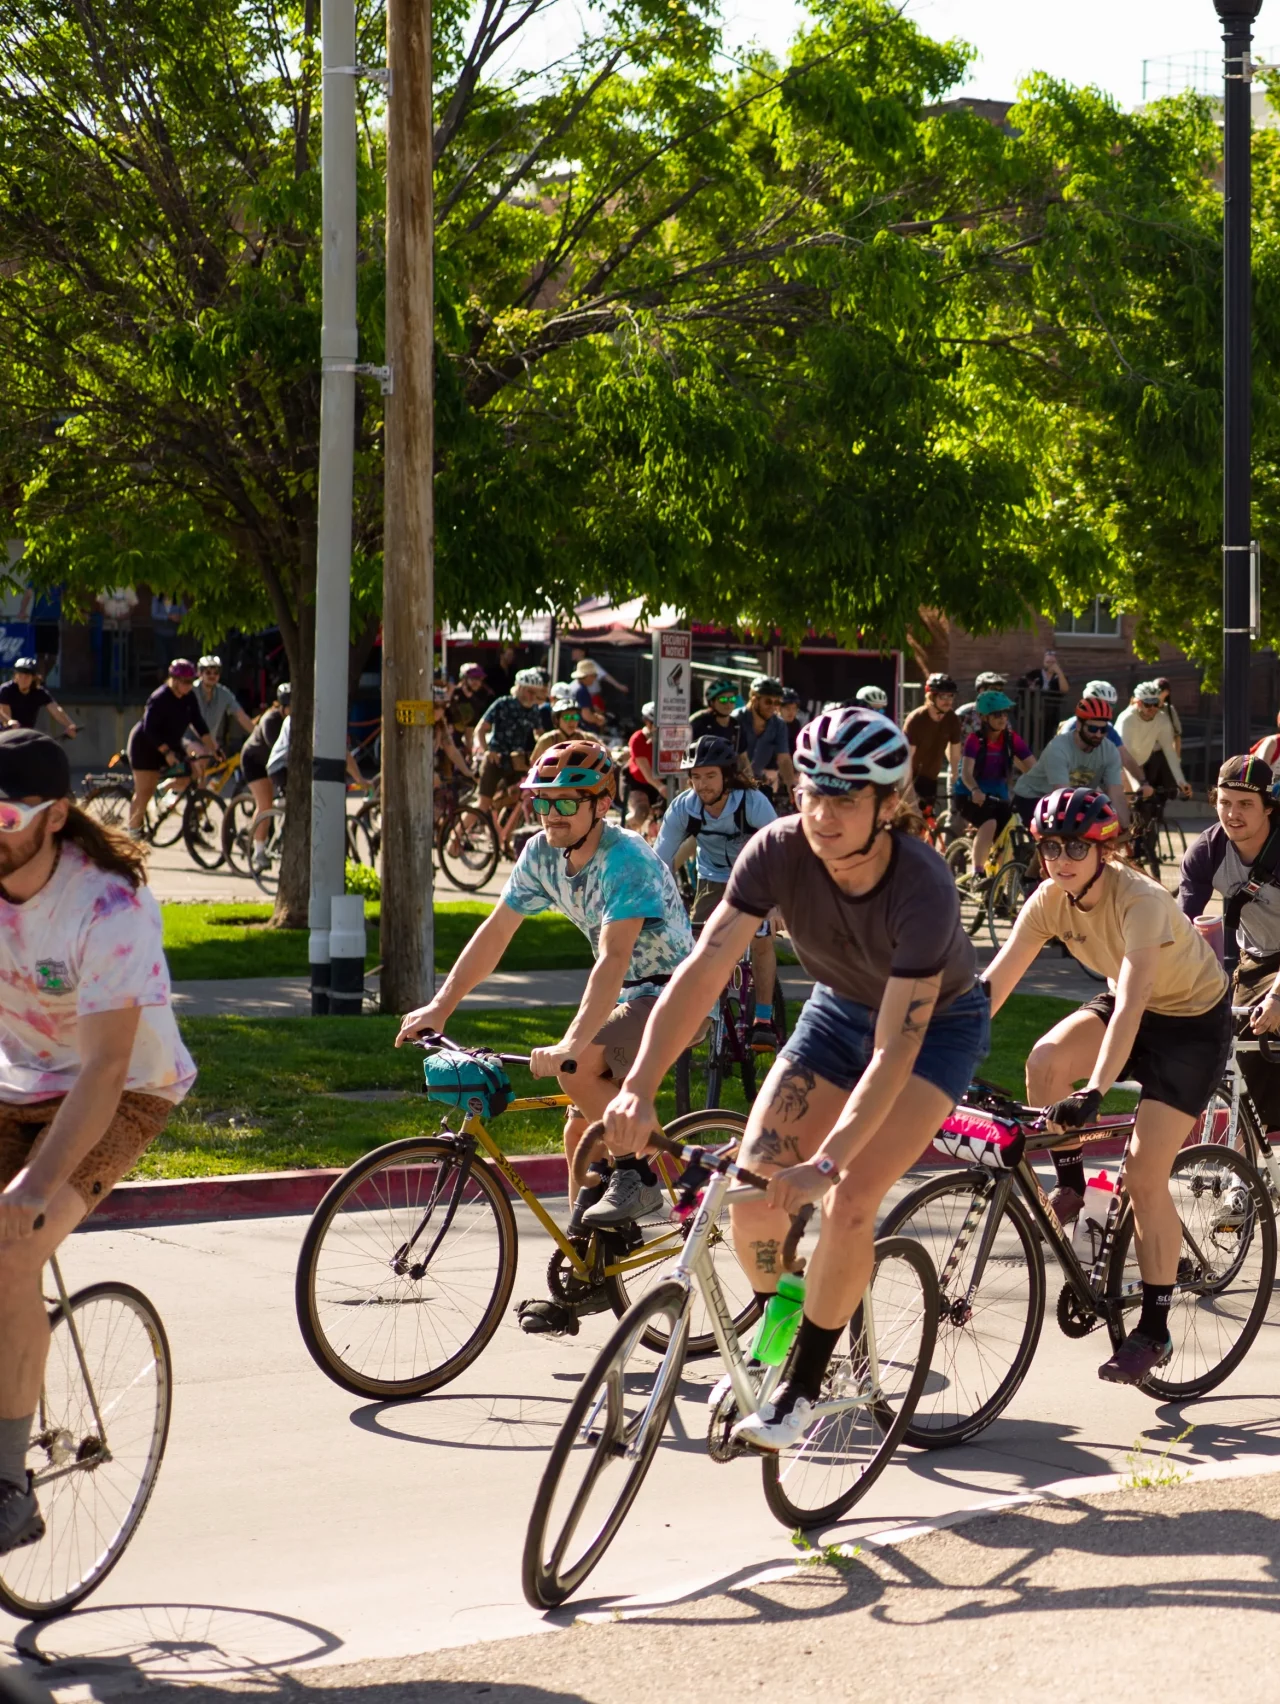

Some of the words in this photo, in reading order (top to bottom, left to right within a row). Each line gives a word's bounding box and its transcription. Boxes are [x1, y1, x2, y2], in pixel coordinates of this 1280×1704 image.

[662, 634, 689, 647] SECURITY
[665, 646, 686, 658] NOTICE
[495, 1152, 530, 1193] SURLY
